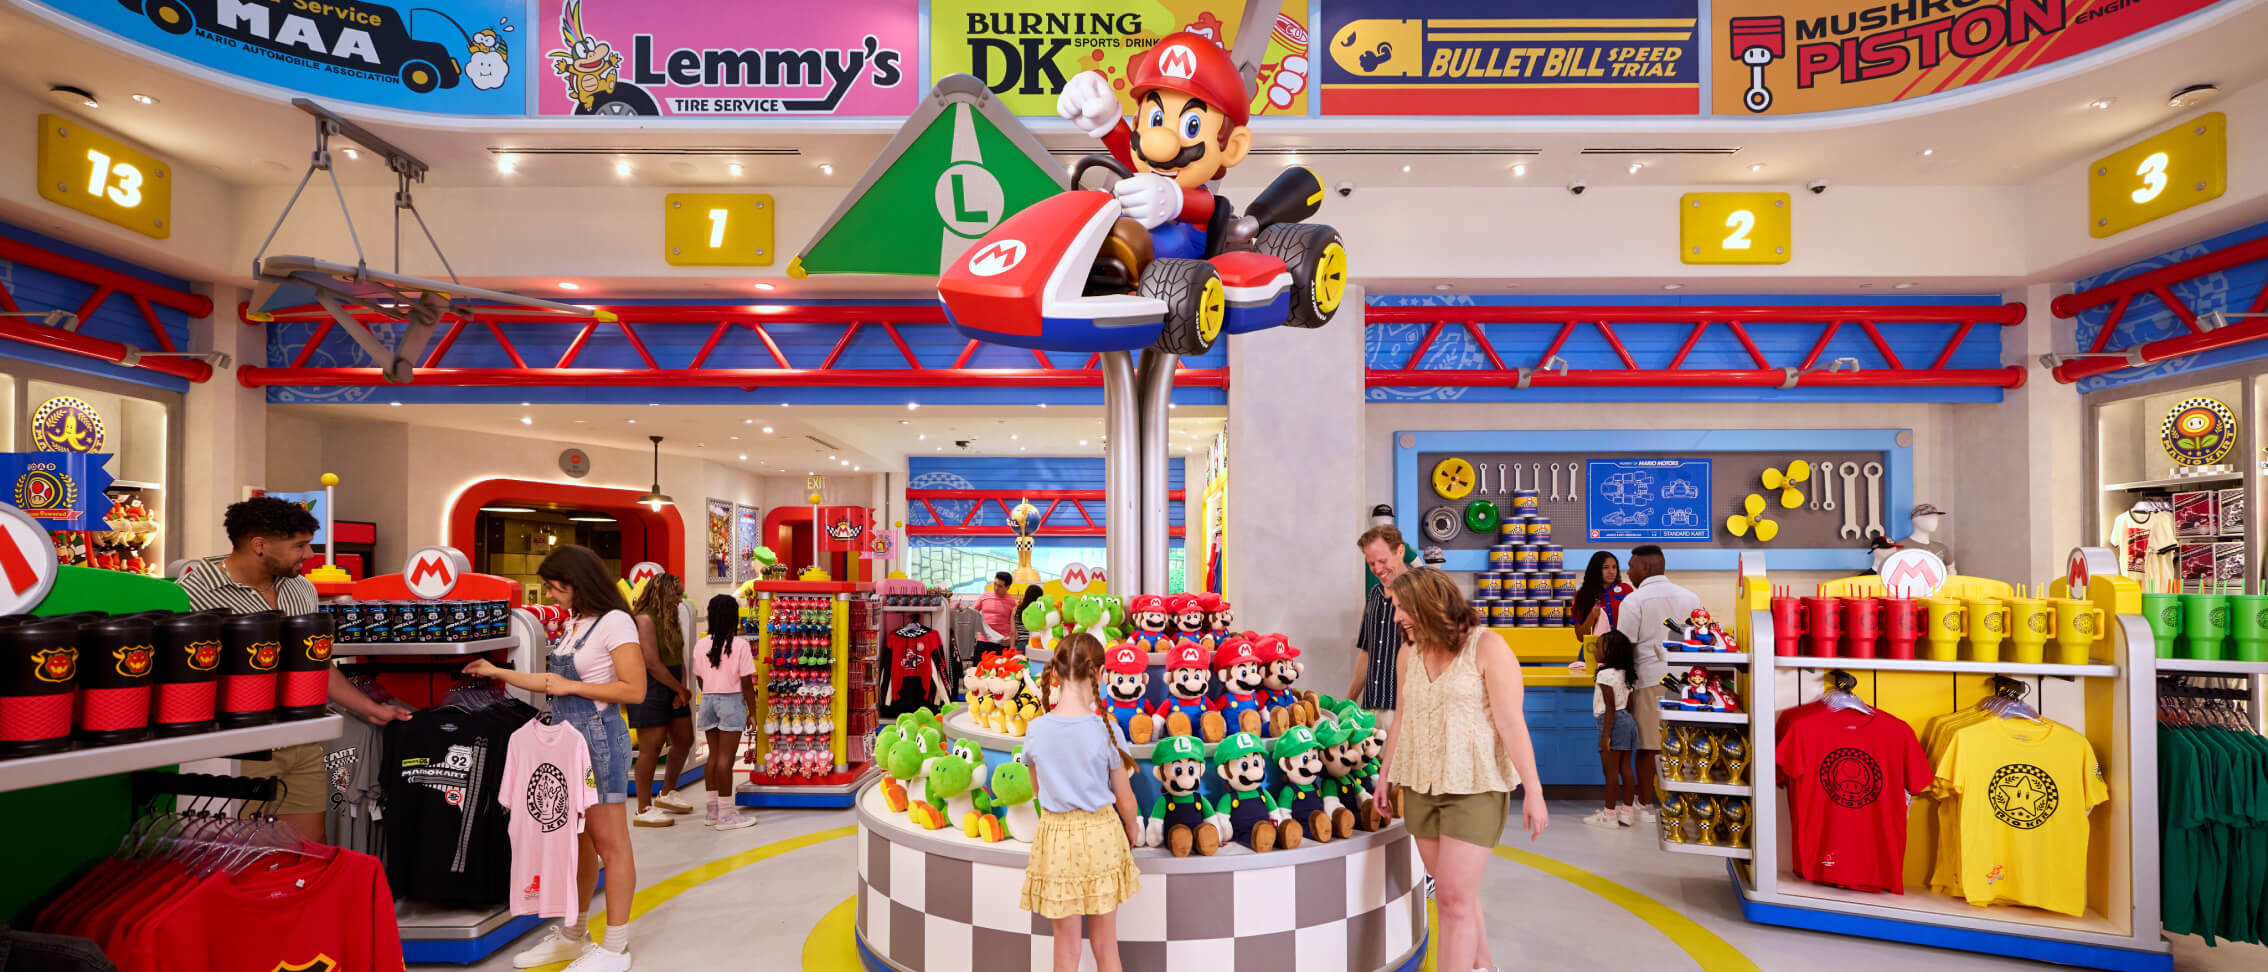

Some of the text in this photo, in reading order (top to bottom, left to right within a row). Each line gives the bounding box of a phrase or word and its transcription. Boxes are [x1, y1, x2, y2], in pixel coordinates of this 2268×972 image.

[293, 0, 382, 27] Service
[967, 13, 1142, 35] BURNING
[217, 0, 381, 65] MAA
[1074, 38, 1121, 48] SPORTS
[1797, 0, 2067, 89] PISTON
[195, 28, 400, 85] MARIO AUTOMOBILE ASSOCIATION
[967, 38, 1072, 96] DK
[1161, 48, 1192, 77] M
[1429, 47, 1605, 78] BULLET BILL
[1607, 47, 1682, 62] SPEED
[1611, 62, 1677, 77] TRIAL
[634, 34, 901, 111] Lemmy's
[675, 99, 779, 113] TIRE SERVICE
[87, 150, 142, 207] 13
[2131, 153, 2169, 204] 3
[951, 174, 989, 224] L
[708, 209, 728, 248] 1
[1722, 210, 1755, 249] 2
[2163, 430, 2234, 465] MARIO KART
[807, 477, 826, 489] EXIT
[410, 556, 452, 587] M
[1064, 568, 1088, 585] M
[1888, 558, 1939, 588] M
[2069, 557, 2088, 588] M
[451, 755, 467, 767] 92
